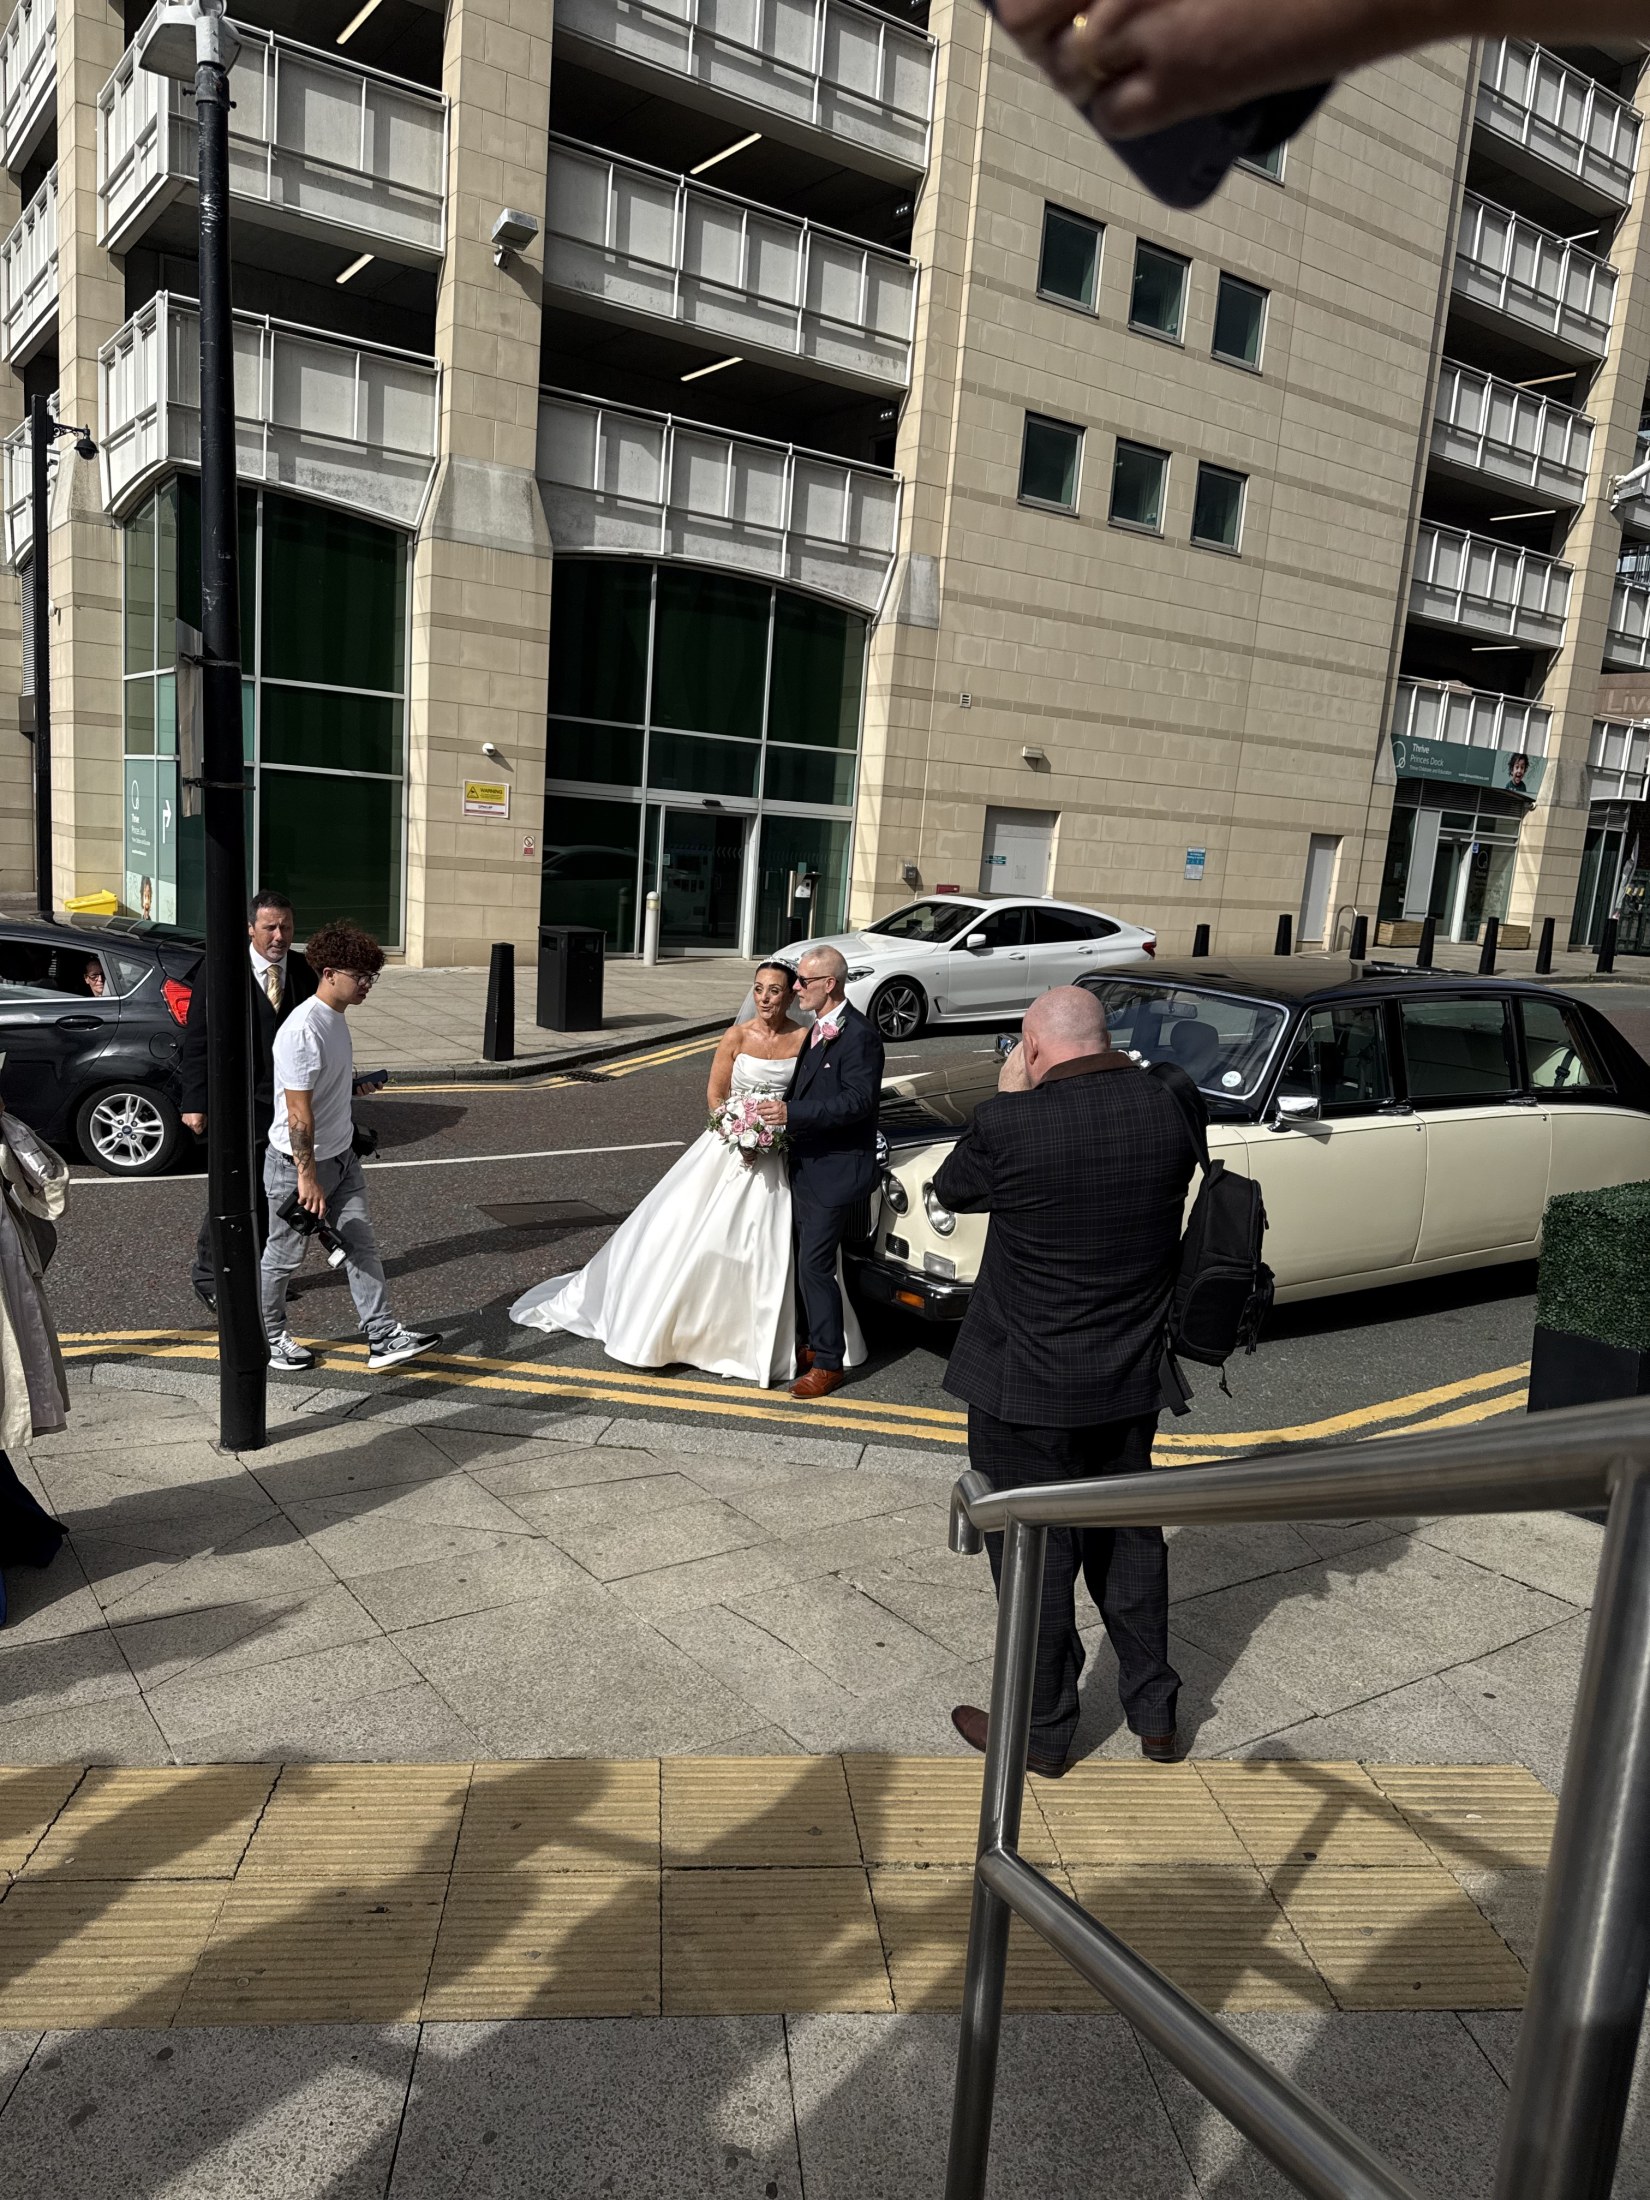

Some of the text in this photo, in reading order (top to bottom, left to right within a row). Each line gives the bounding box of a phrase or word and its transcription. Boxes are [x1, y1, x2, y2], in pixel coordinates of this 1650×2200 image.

[1412, 743, 1430, 753] Thrive
[1410, 754, 1444, 767] Princes Dock
